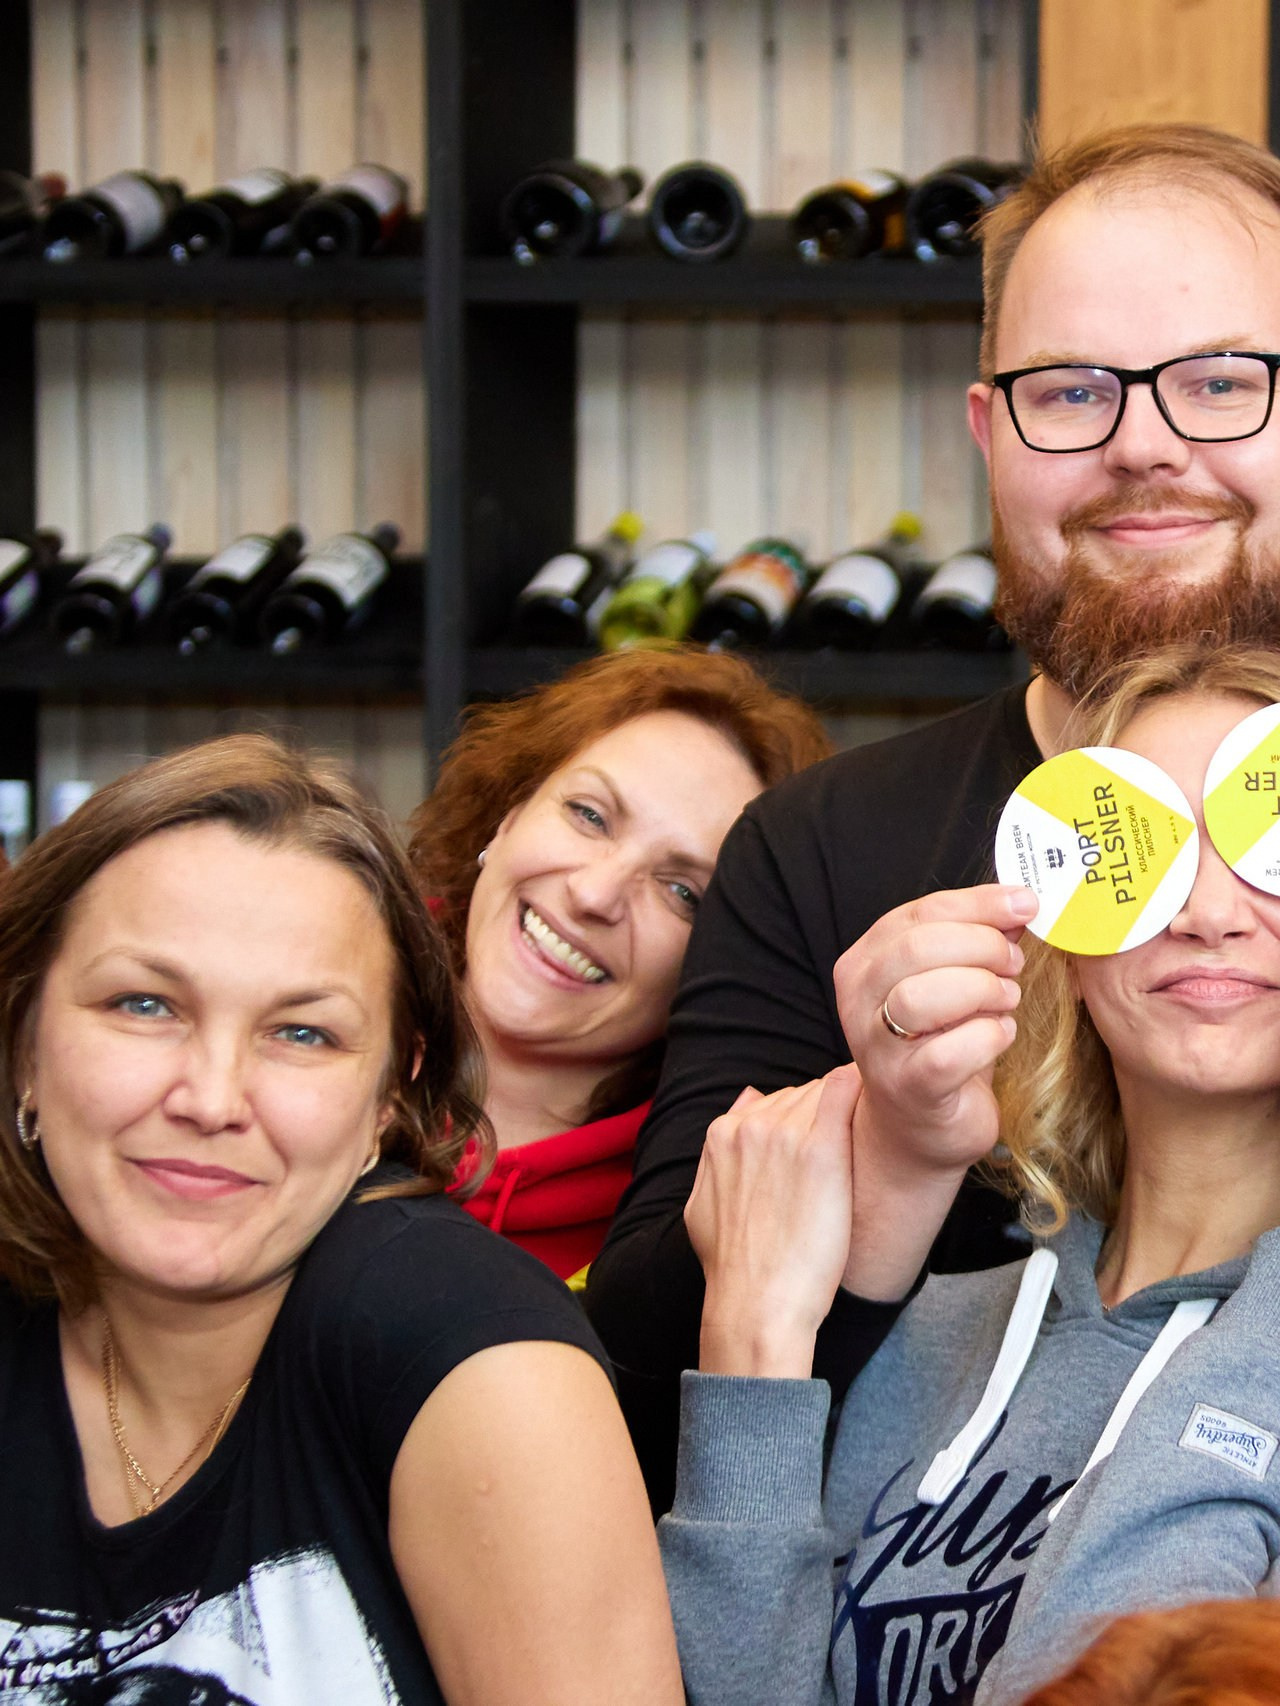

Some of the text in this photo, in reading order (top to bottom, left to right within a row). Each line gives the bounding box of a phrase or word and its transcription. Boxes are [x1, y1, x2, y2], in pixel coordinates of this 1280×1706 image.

[1012, 824, 1033, 889] AMTEAM BREW
[1073, 818, 1106, 884] PORT
[1093, 782, 1137, 904] PILSNER
[1126, 805, 1148, 873] КЛАССИЧЕСКИЙ
[1141, 816, 1156, 857] ПИЛСНЕР
[1196, 1423, 1266, 1457] Superdry
[834, 1409, 1078, 1620] Sup
